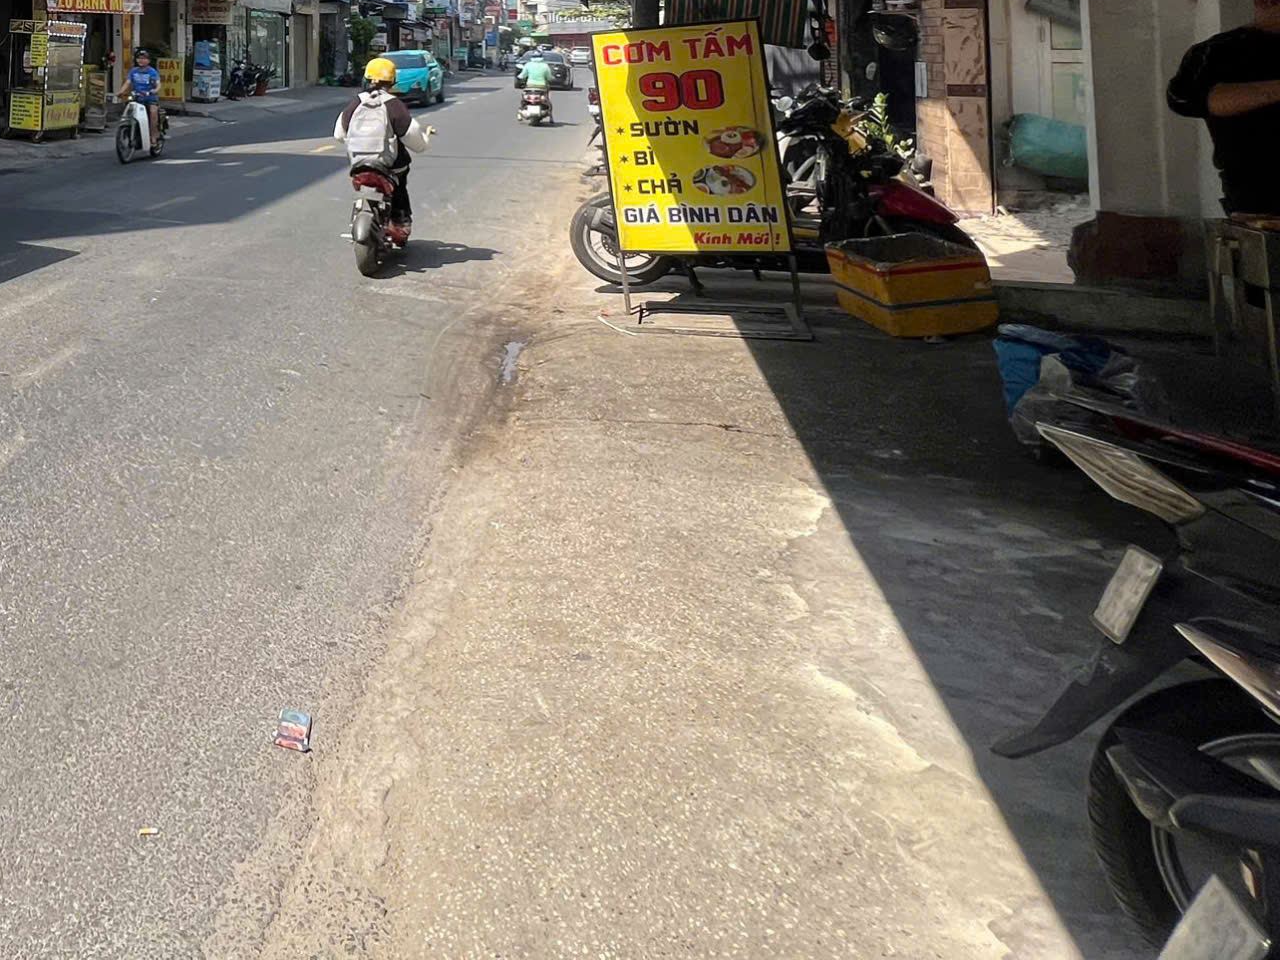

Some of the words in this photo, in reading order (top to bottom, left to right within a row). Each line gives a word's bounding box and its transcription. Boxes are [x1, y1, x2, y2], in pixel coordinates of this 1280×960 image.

[602, 39, 671, 66] CƠM
[683, 27, 754, 60] TẤM
[639, 69, 725, 112] 90
[630, 116, 699, 137] SƯỜN
[634, 147, 655, 166] BÌ
[637, 173, 682, 194] CHẢ
[624, 203, 660, 223] GIÁ
[669, 202, 720, 223] BÌNH
[728, 203, 778, 223] DÂN
